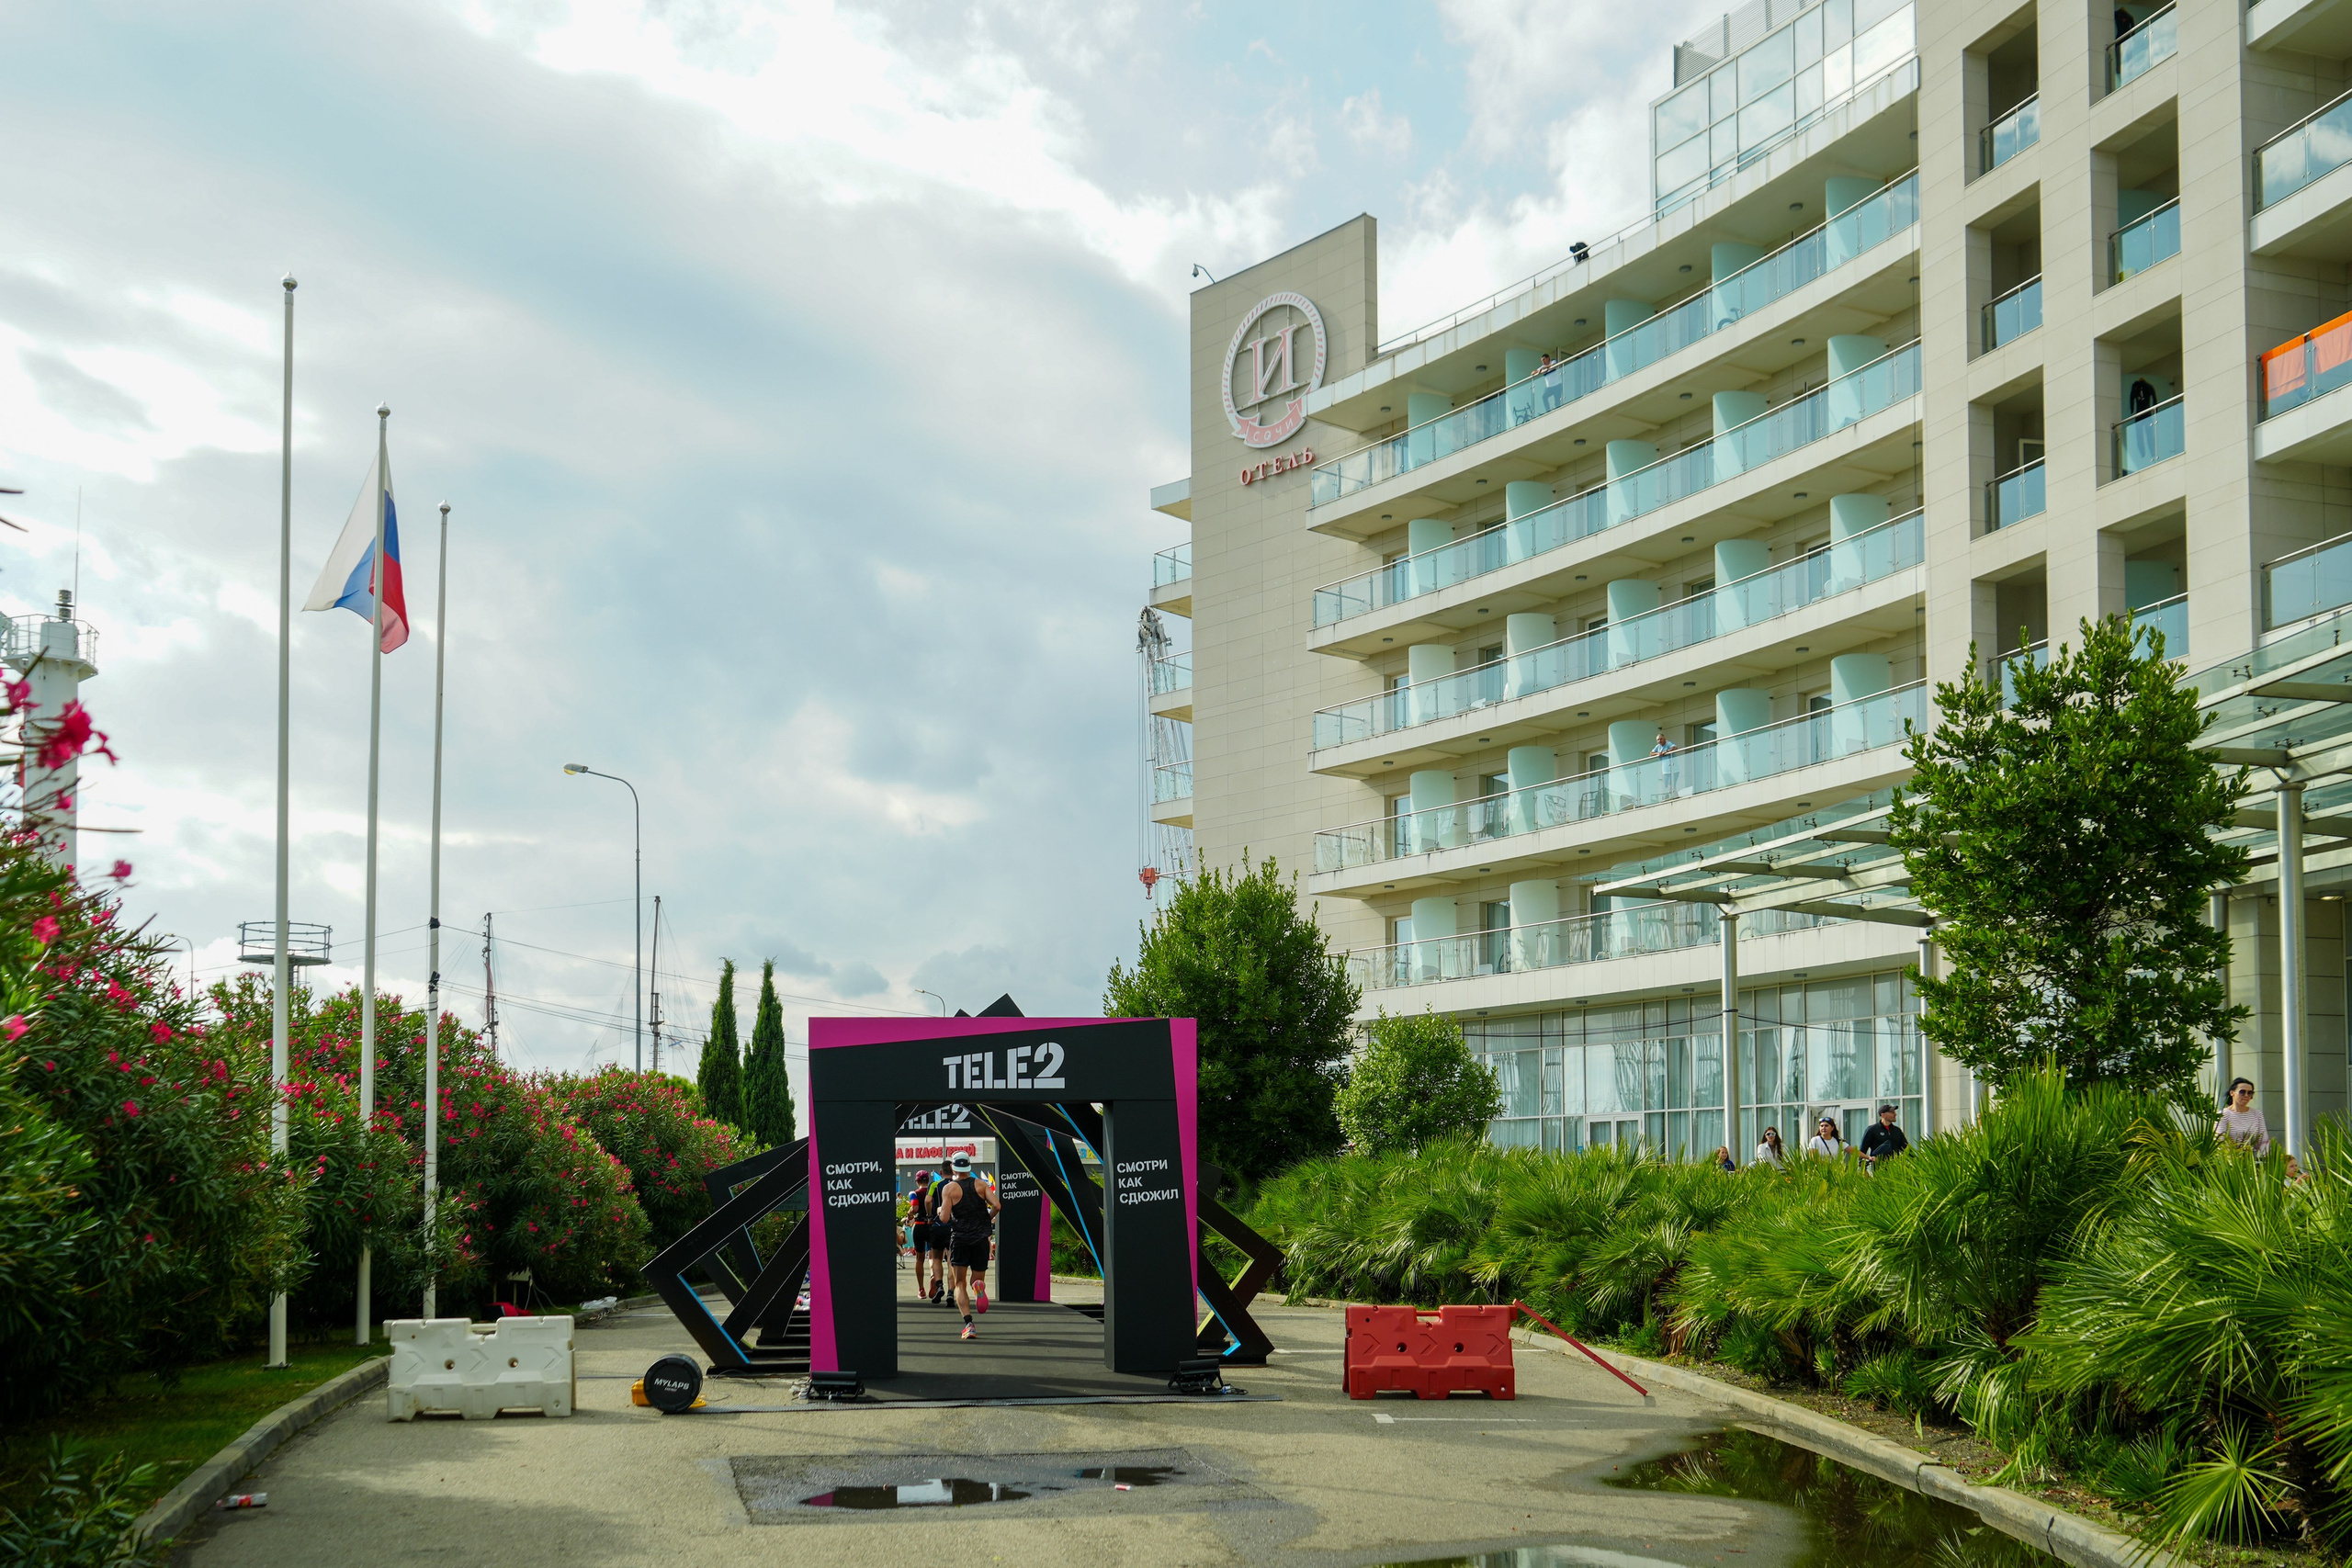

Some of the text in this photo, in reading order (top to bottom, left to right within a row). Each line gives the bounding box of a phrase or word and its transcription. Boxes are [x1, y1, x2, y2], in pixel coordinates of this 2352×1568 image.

[1253, 418, 1294, 442] СОЧИ
[1239, 446, 1315, 485] ОТЕЛЬ
[943, 1042, 1065, 1089] TELE2
[905, 1147, 914, 1158] И
[826, 1160, 883, 1176] СМОТРИ,
[1116, 1159, 1168, 1174] СМОТРИ
[827, 1179, 853, 1190] КАК
[1001, 1182, 1017, 1190] КАК
[1118, 1177, 1143, 1189] КАК
[828, 1191, 890, 1208] СДЮЖИЛ
[1002, 1190, 1039, 1200] СДЮЖИЛ
[1119, 1189, 1179, 1205] СДЮЖИЛ
[653, 1378, 690, 1391] MYLAPS
